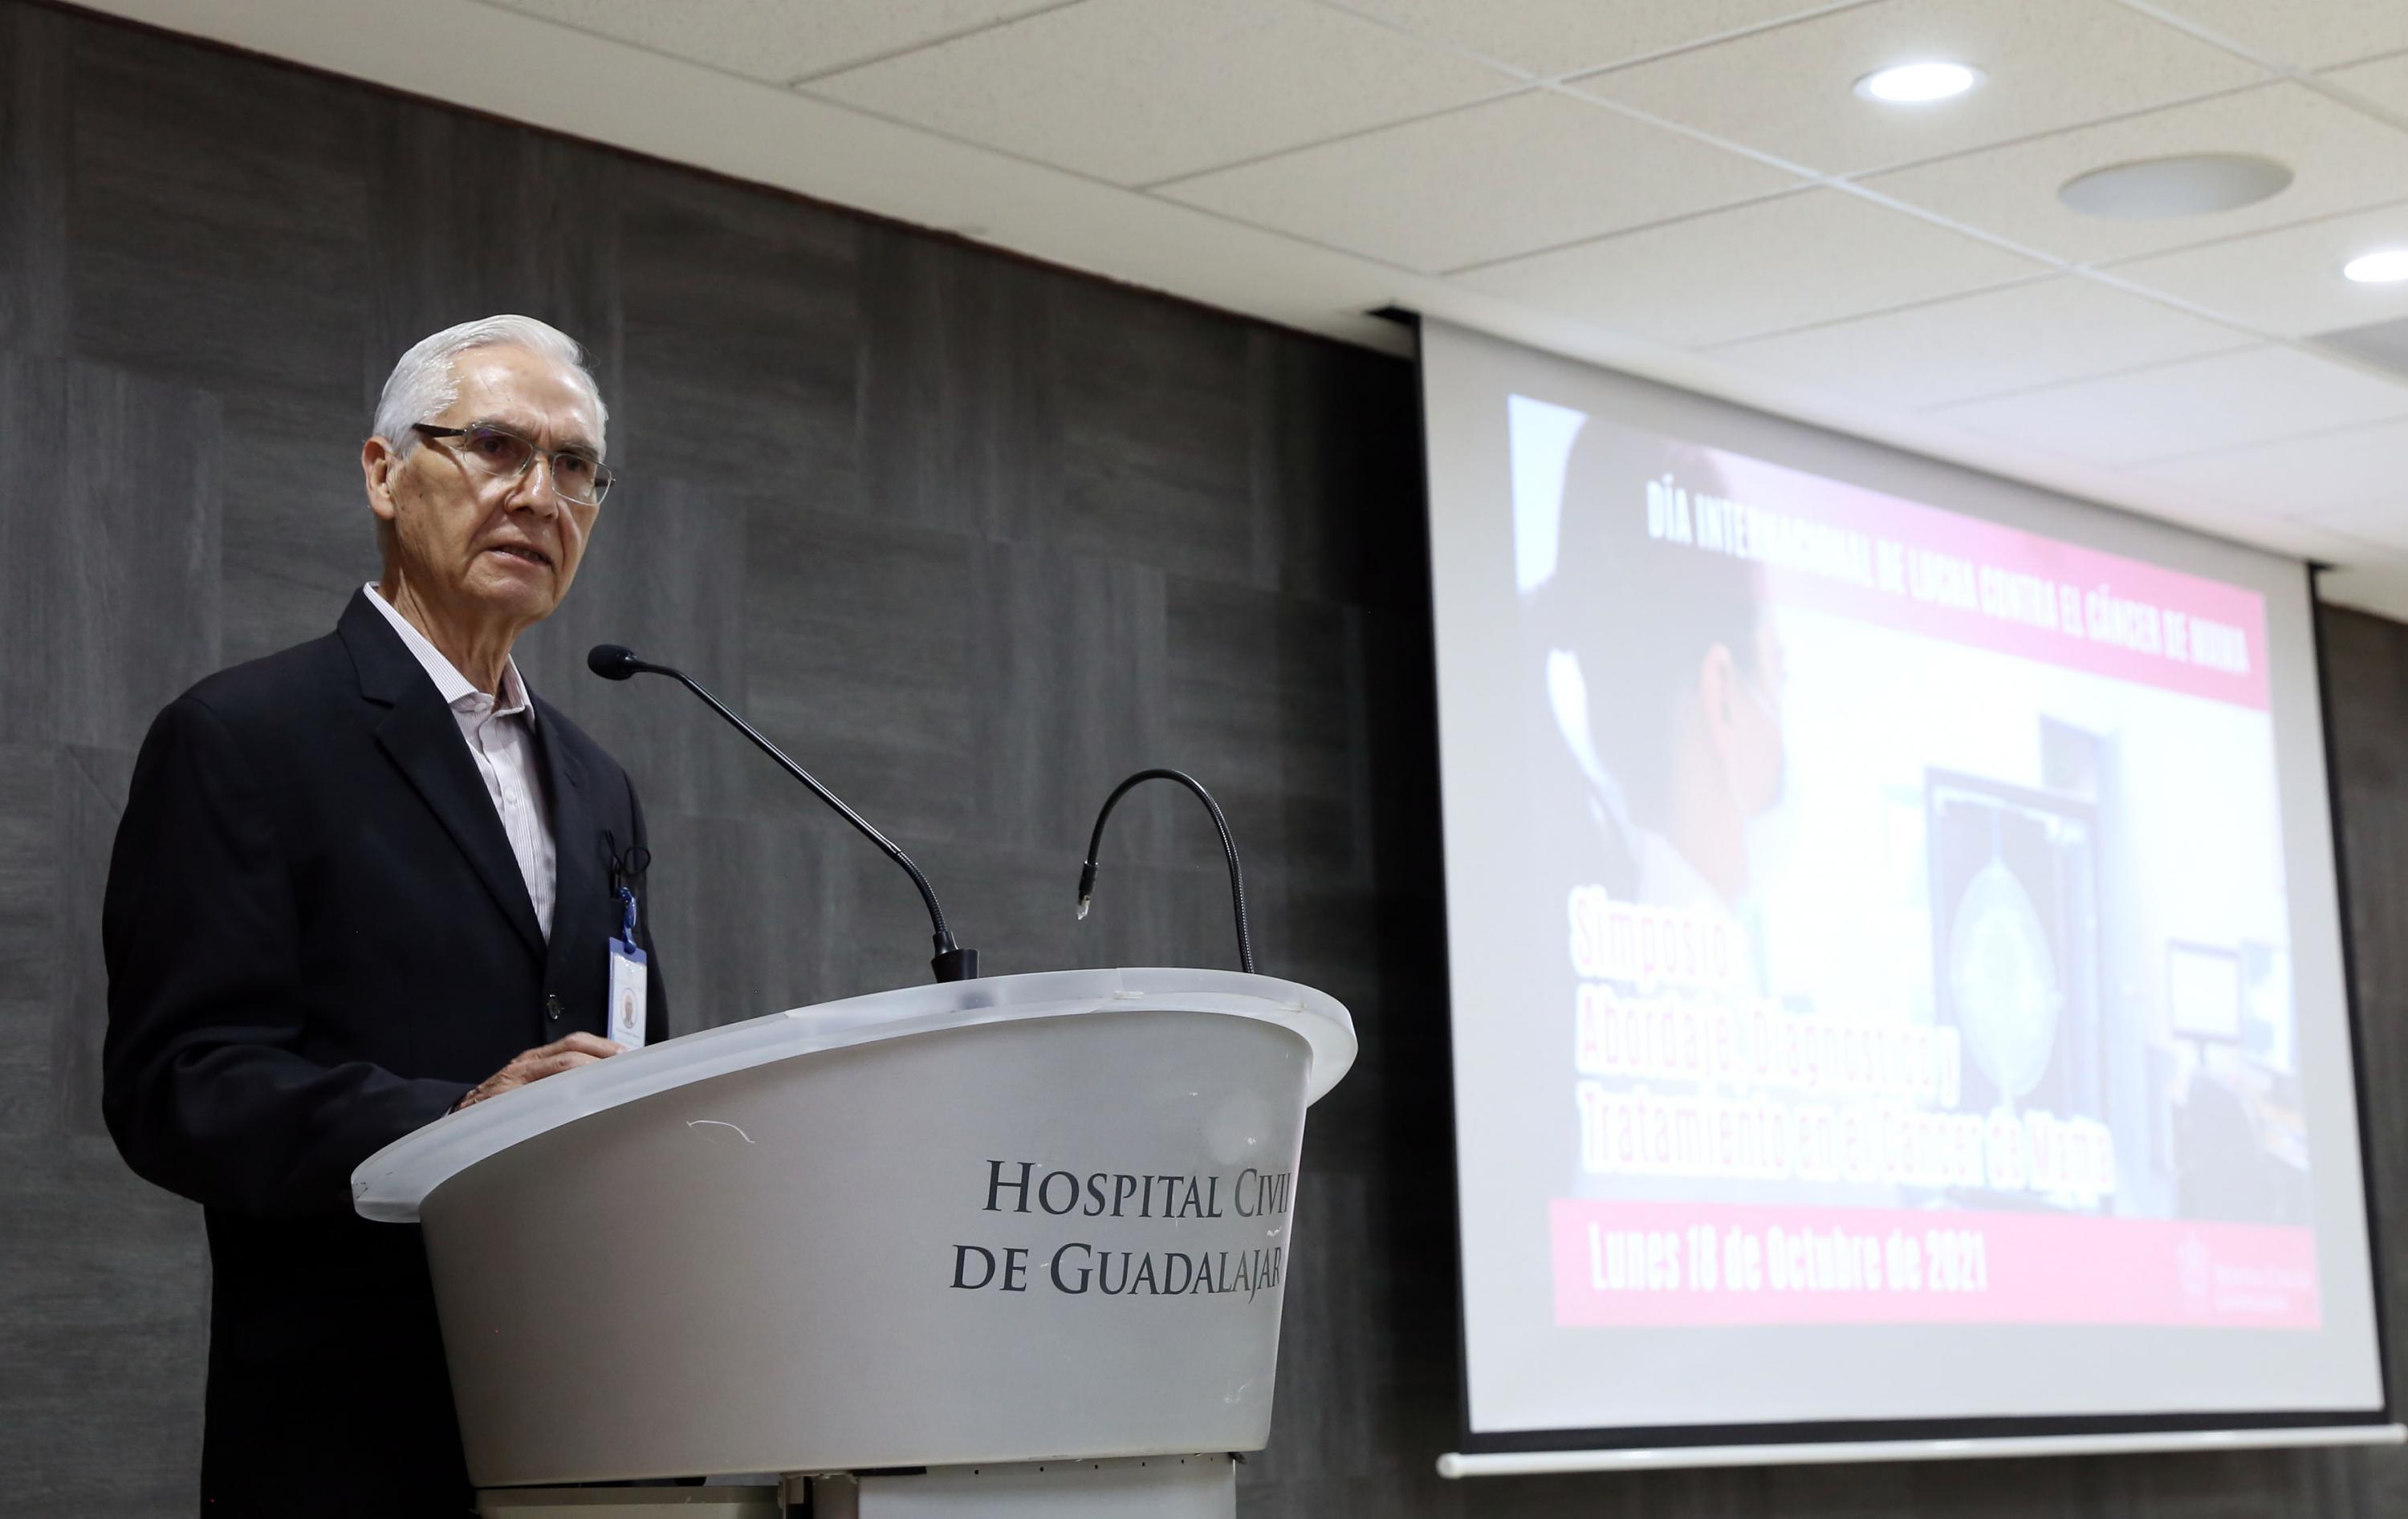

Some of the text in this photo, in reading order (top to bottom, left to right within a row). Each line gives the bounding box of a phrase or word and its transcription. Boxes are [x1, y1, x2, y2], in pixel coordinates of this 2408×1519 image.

[1646, 473, 1692, 544] DÍA
[1875, 538, 1906, 595] DE
[2058, 582, 2085, 639] EL
[2162, 608, 2190, 664] DE
[1570, 887, 1735, 991] Simposio
[1579, 1081, 1790, 1179] Tratamiento
[982, 1160, 1222, 1218] HOSPITAL
[950, 1243, 1283, 1304] DE GUADALAJAR
[1588, 1221, 1682, 1291] Lunes
[1723, 1224, 1762, 1291] de
[1767, 1224, 1882, 1291] Octubre
[1885, 1225, 1922, 1291] de
[1926, 1228, 1988, 1292] 2021
